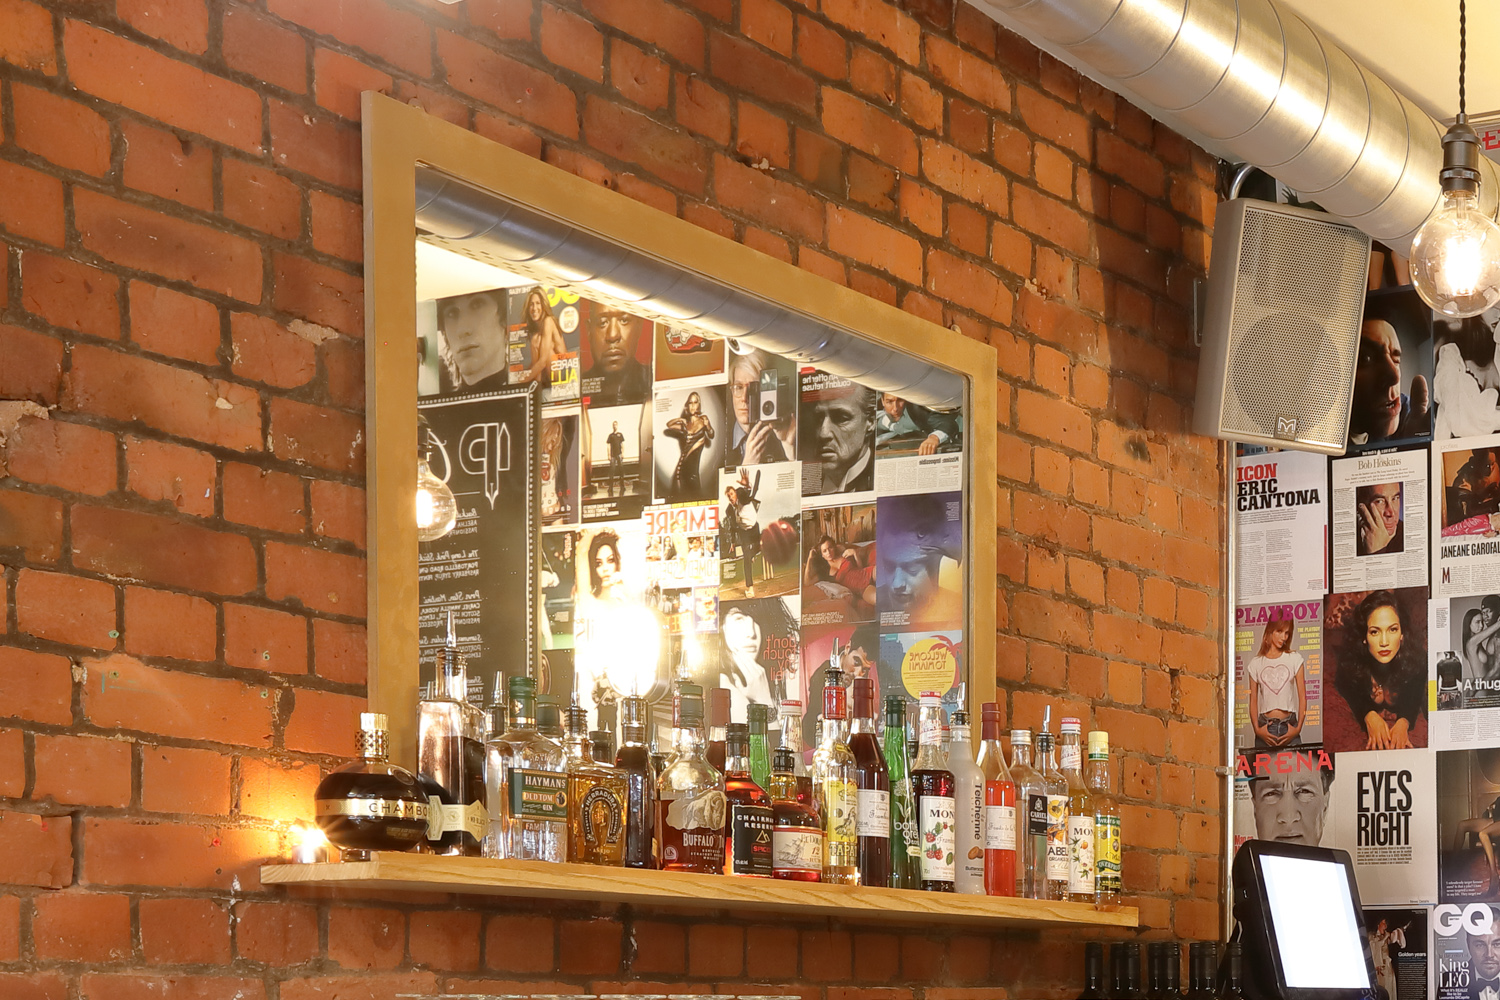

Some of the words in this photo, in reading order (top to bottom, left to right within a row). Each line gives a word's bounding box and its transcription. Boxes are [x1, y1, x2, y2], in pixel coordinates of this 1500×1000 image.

[1237, 462, 1277, 482] ICON
[1358, 459, 1372, 470] Bob
[1374, 456, 1402, 469] Hoskins
[1237, 479, 1278, 496] ERIC
[1237, 489, 1320, 512] CANTONA
[1441, 543, 1470, 560] JANEANE
[1235, 602, 1320, 624] PLAYBOY
[1464, 679, 1472, 691] A
[1357, 770, 1412, 812] EYES
[1357, 811, 1412, 846] RIGHT
[683, 832, 714, 848] BUFFALO
